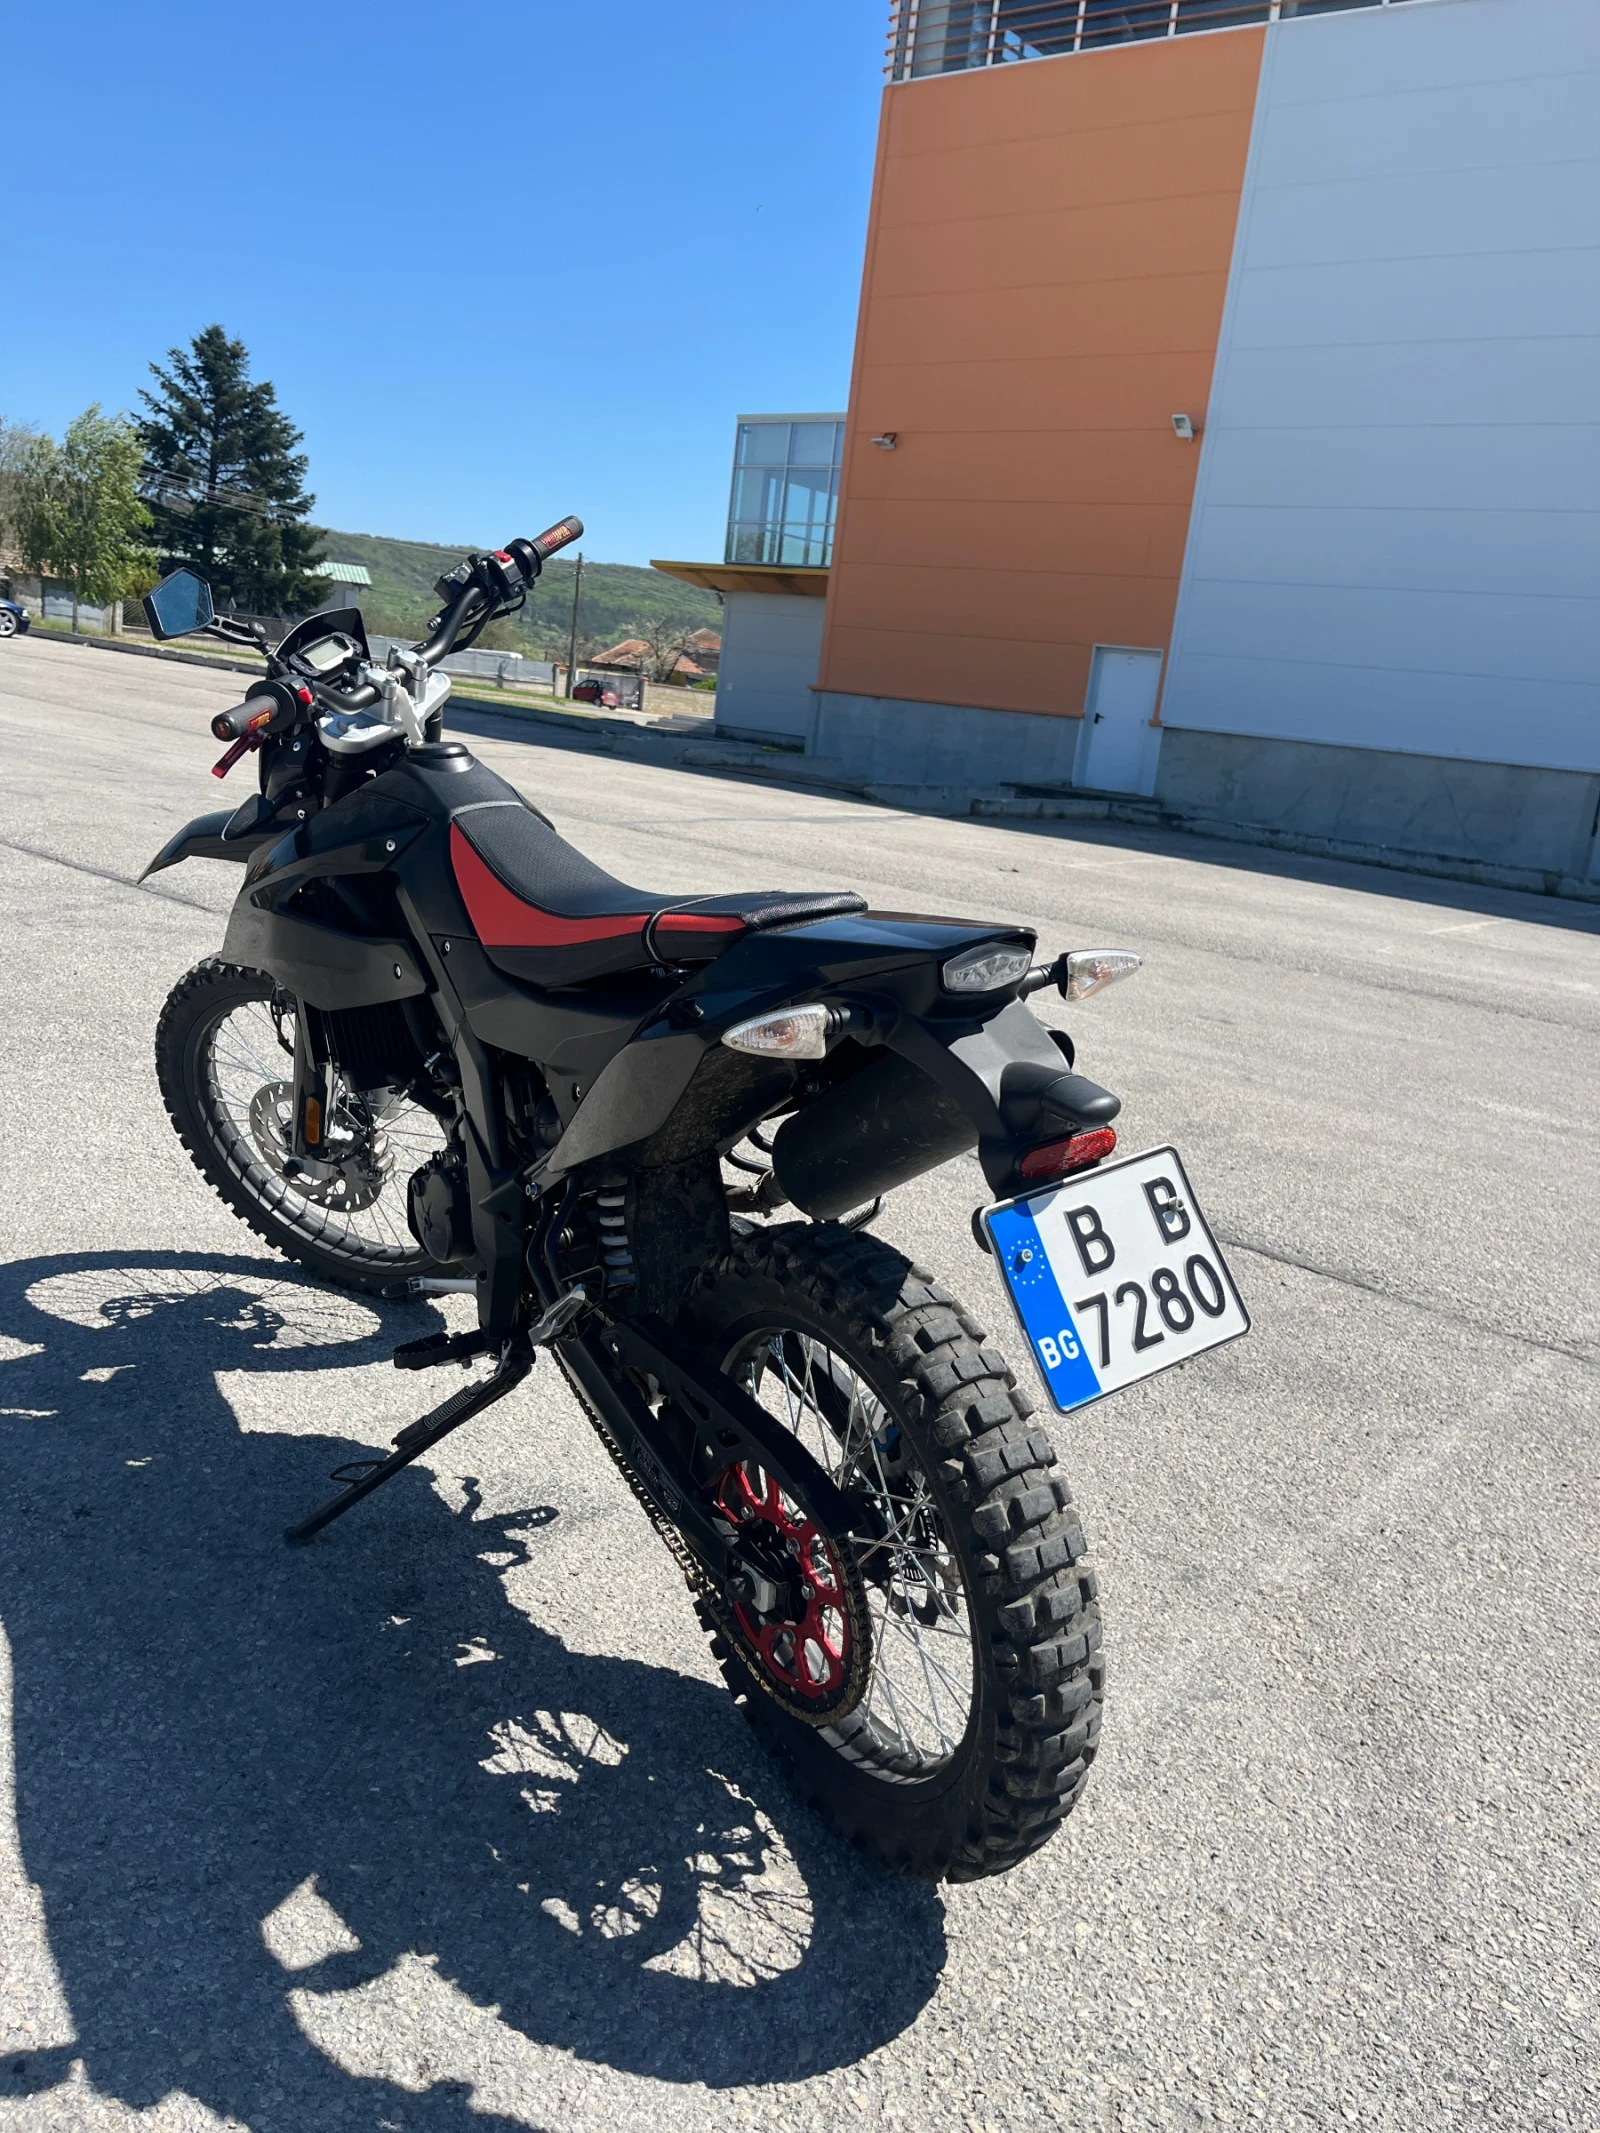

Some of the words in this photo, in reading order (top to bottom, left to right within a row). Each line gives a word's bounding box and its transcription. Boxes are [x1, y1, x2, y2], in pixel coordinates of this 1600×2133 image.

[1064, 1205, 1115, 1277] B
[1142, 1177, 1191, 1246] B
[1038, 1329, 1080, 1369] BG
[1074, 1254, 1226, 1368] 7280
